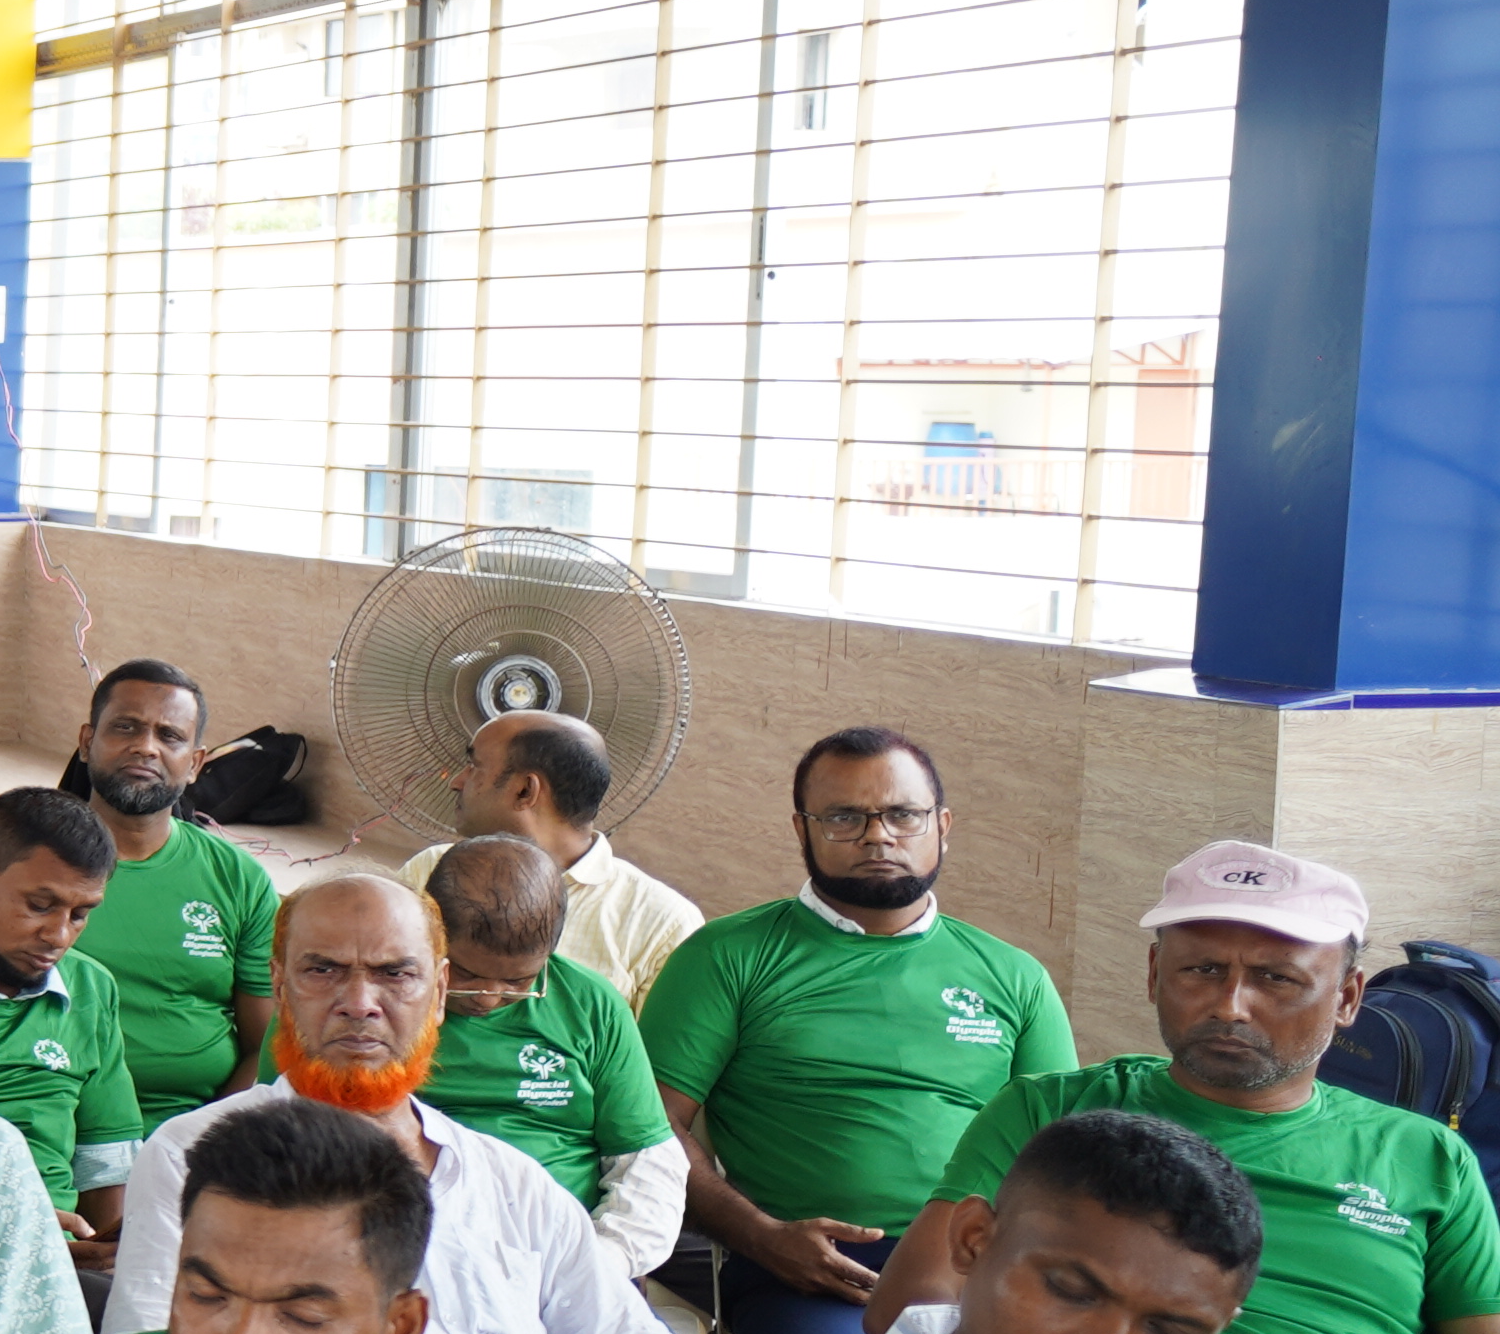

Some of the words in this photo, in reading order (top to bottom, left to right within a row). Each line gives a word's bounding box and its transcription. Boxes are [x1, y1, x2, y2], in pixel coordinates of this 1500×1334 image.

[948, 1016, 998, 1028] Special
[946, 1025, 1003, 1037] Olympics
[520, 1080, 570, 1090] Special
[516, 1089, 575, 1100] Olympics
